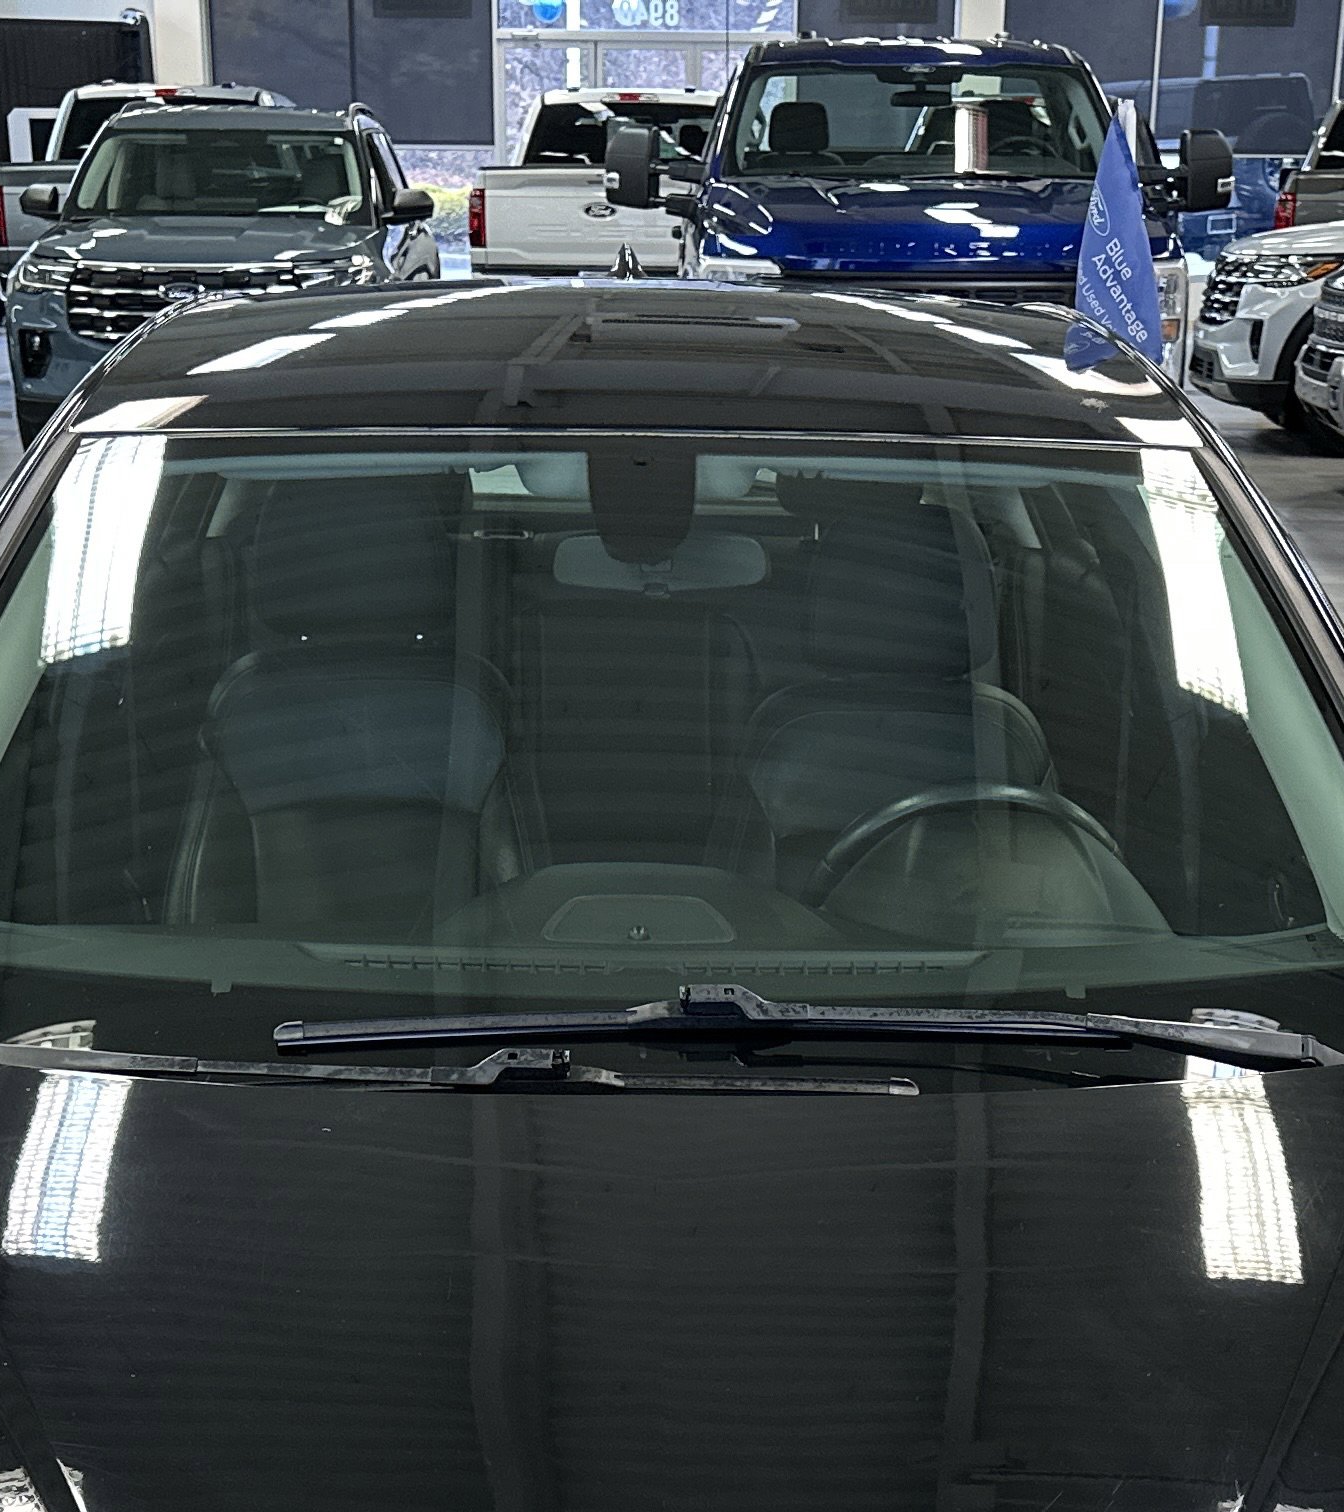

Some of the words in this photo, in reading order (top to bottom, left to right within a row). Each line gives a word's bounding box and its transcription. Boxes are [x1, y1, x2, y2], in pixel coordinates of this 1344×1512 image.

[1105, 237, 1133, 281] Blue
[1082, 283, 1106, 316] Used
[1092, 253, 1149, 343] Advantage
